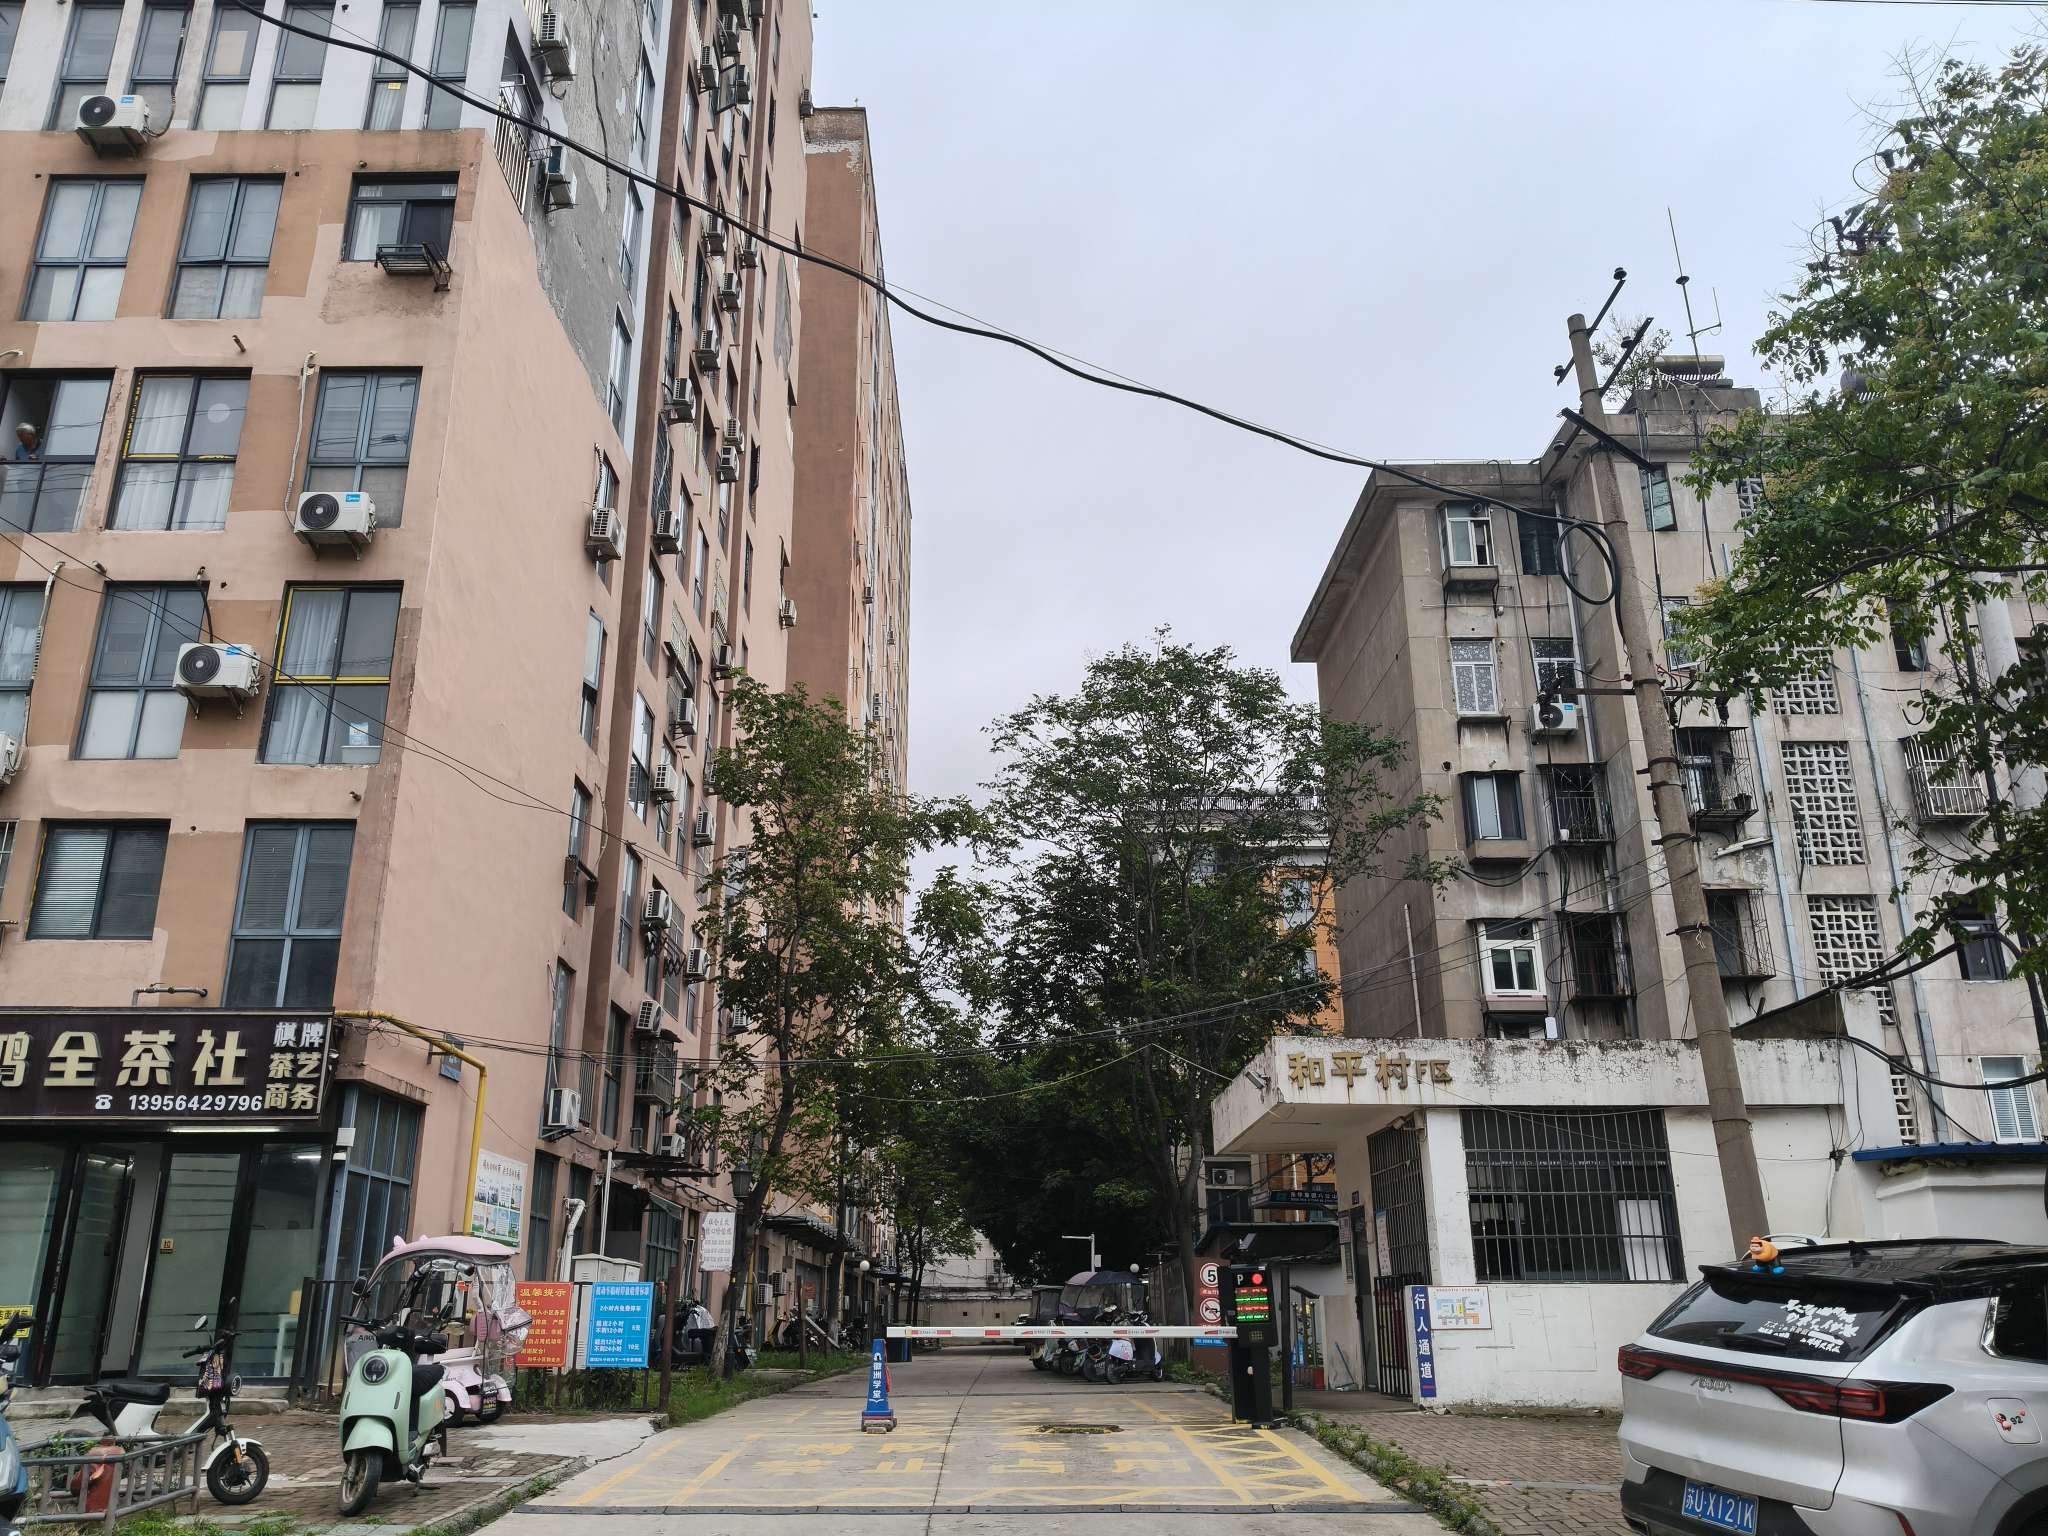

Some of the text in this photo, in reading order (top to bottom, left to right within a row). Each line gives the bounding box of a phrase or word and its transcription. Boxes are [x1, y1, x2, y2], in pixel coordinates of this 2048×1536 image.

[273, 1021, 325, 1047] 棋牌
[268, 1052, 322, 1079] 茶艺
[1287, 1051, 1453, 1090] 和平村F区
[128, 1094, 263, 1112] 13956429796
[263, 1082, 317, 1110] 商务
[1207, 1269, 1217, 1283] 5
[519, 1287, 567, 1297] 温馨提示
[1414, 1293, 1433, 1379] 行人通道
